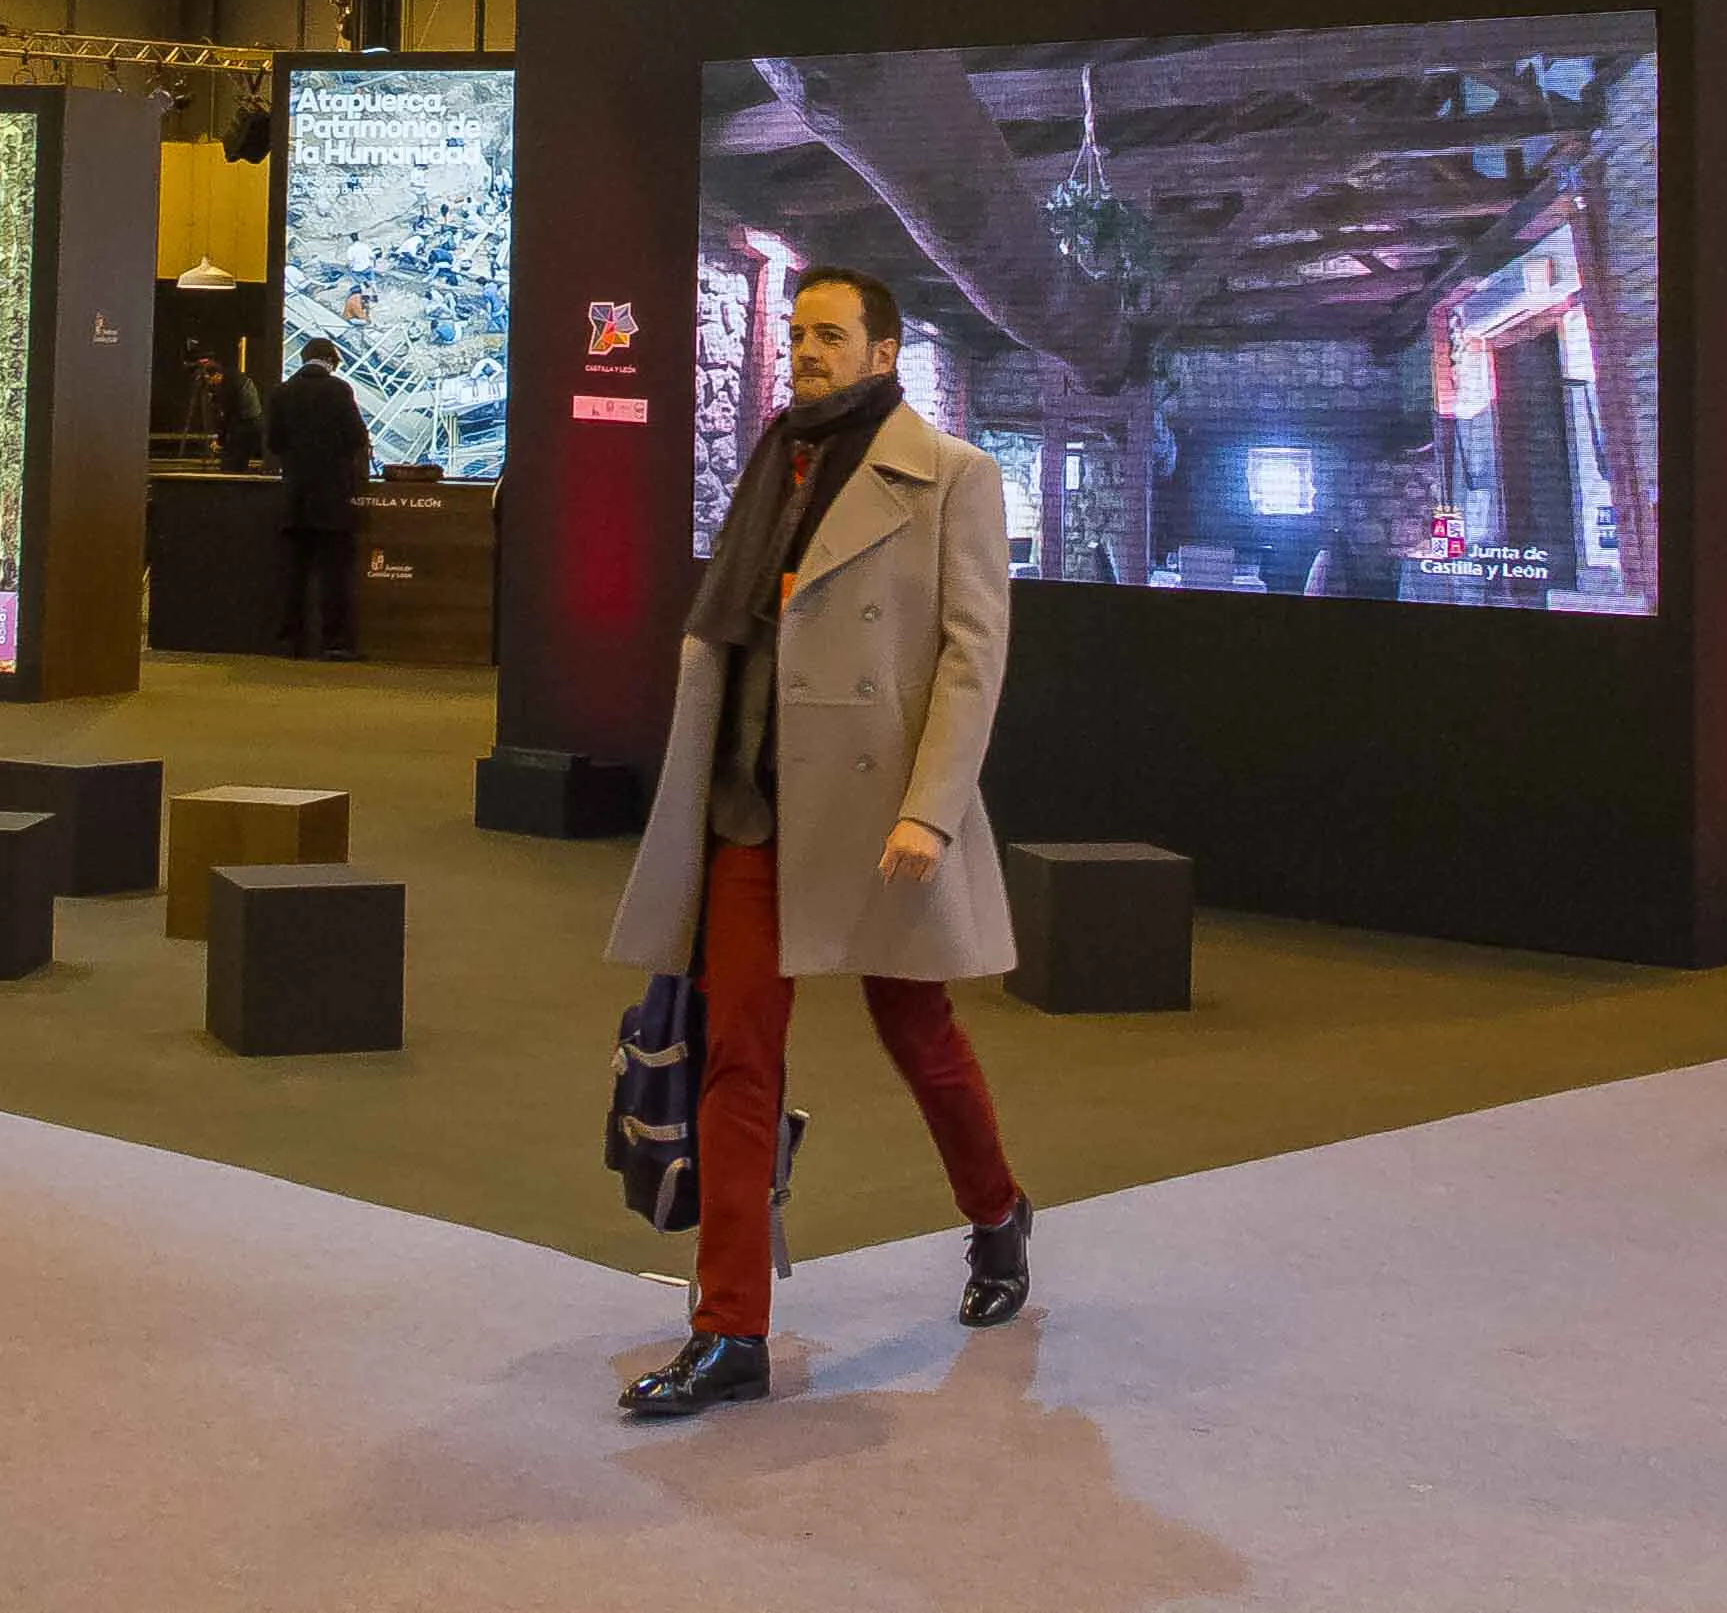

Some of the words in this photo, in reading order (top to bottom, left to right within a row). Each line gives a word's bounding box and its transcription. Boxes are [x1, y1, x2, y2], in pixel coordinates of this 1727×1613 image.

[295, 88, 448, 119] Atapuerca,
[296, 113, 442, 139] Patrimonio
[447, 113, 482, 139] de
[295, 138, 320, 165] la
[325, 138, 481, 165] Humanidad
[351, 496, 397, 507] ASTILLA
[1469, 543, 1521, 560] Junta
[1524, 546, 1549, 562] de
[1421, 559, 1484, 577] Castilla
[1486, 564, 1499, 581] y
[1502, 562, 1549, 580] León
